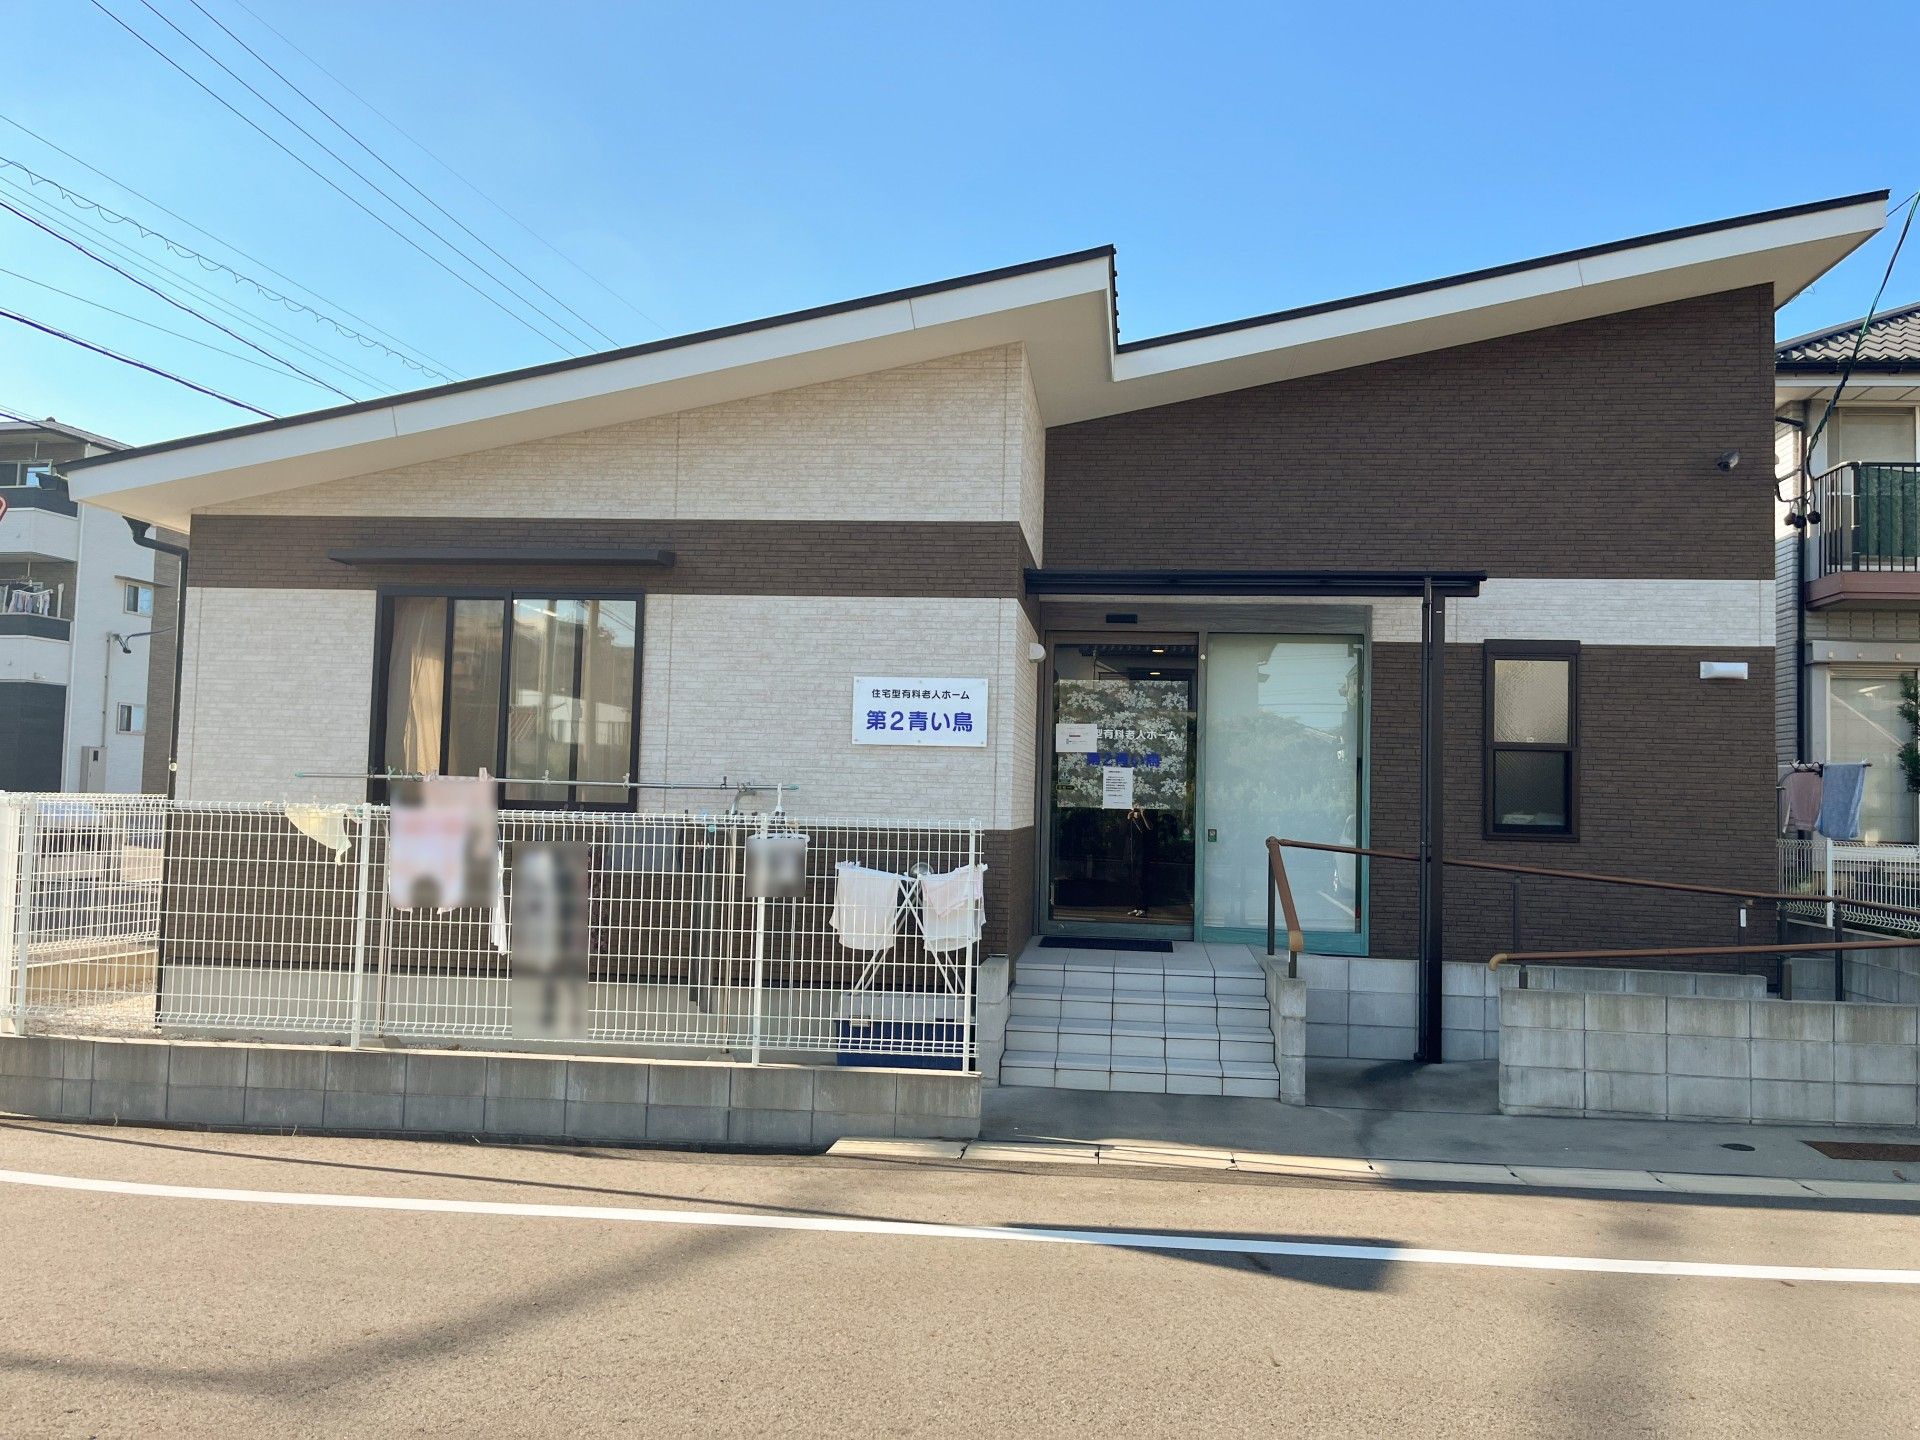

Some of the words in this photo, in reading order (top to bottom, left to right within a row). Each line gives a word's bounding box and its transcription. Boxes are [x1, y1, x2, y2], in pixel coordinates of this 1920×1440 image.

[871, 688, 970, 700] 住宅型有料老人ホーム
[866, 709, 973, 732] 第2青い鳥
